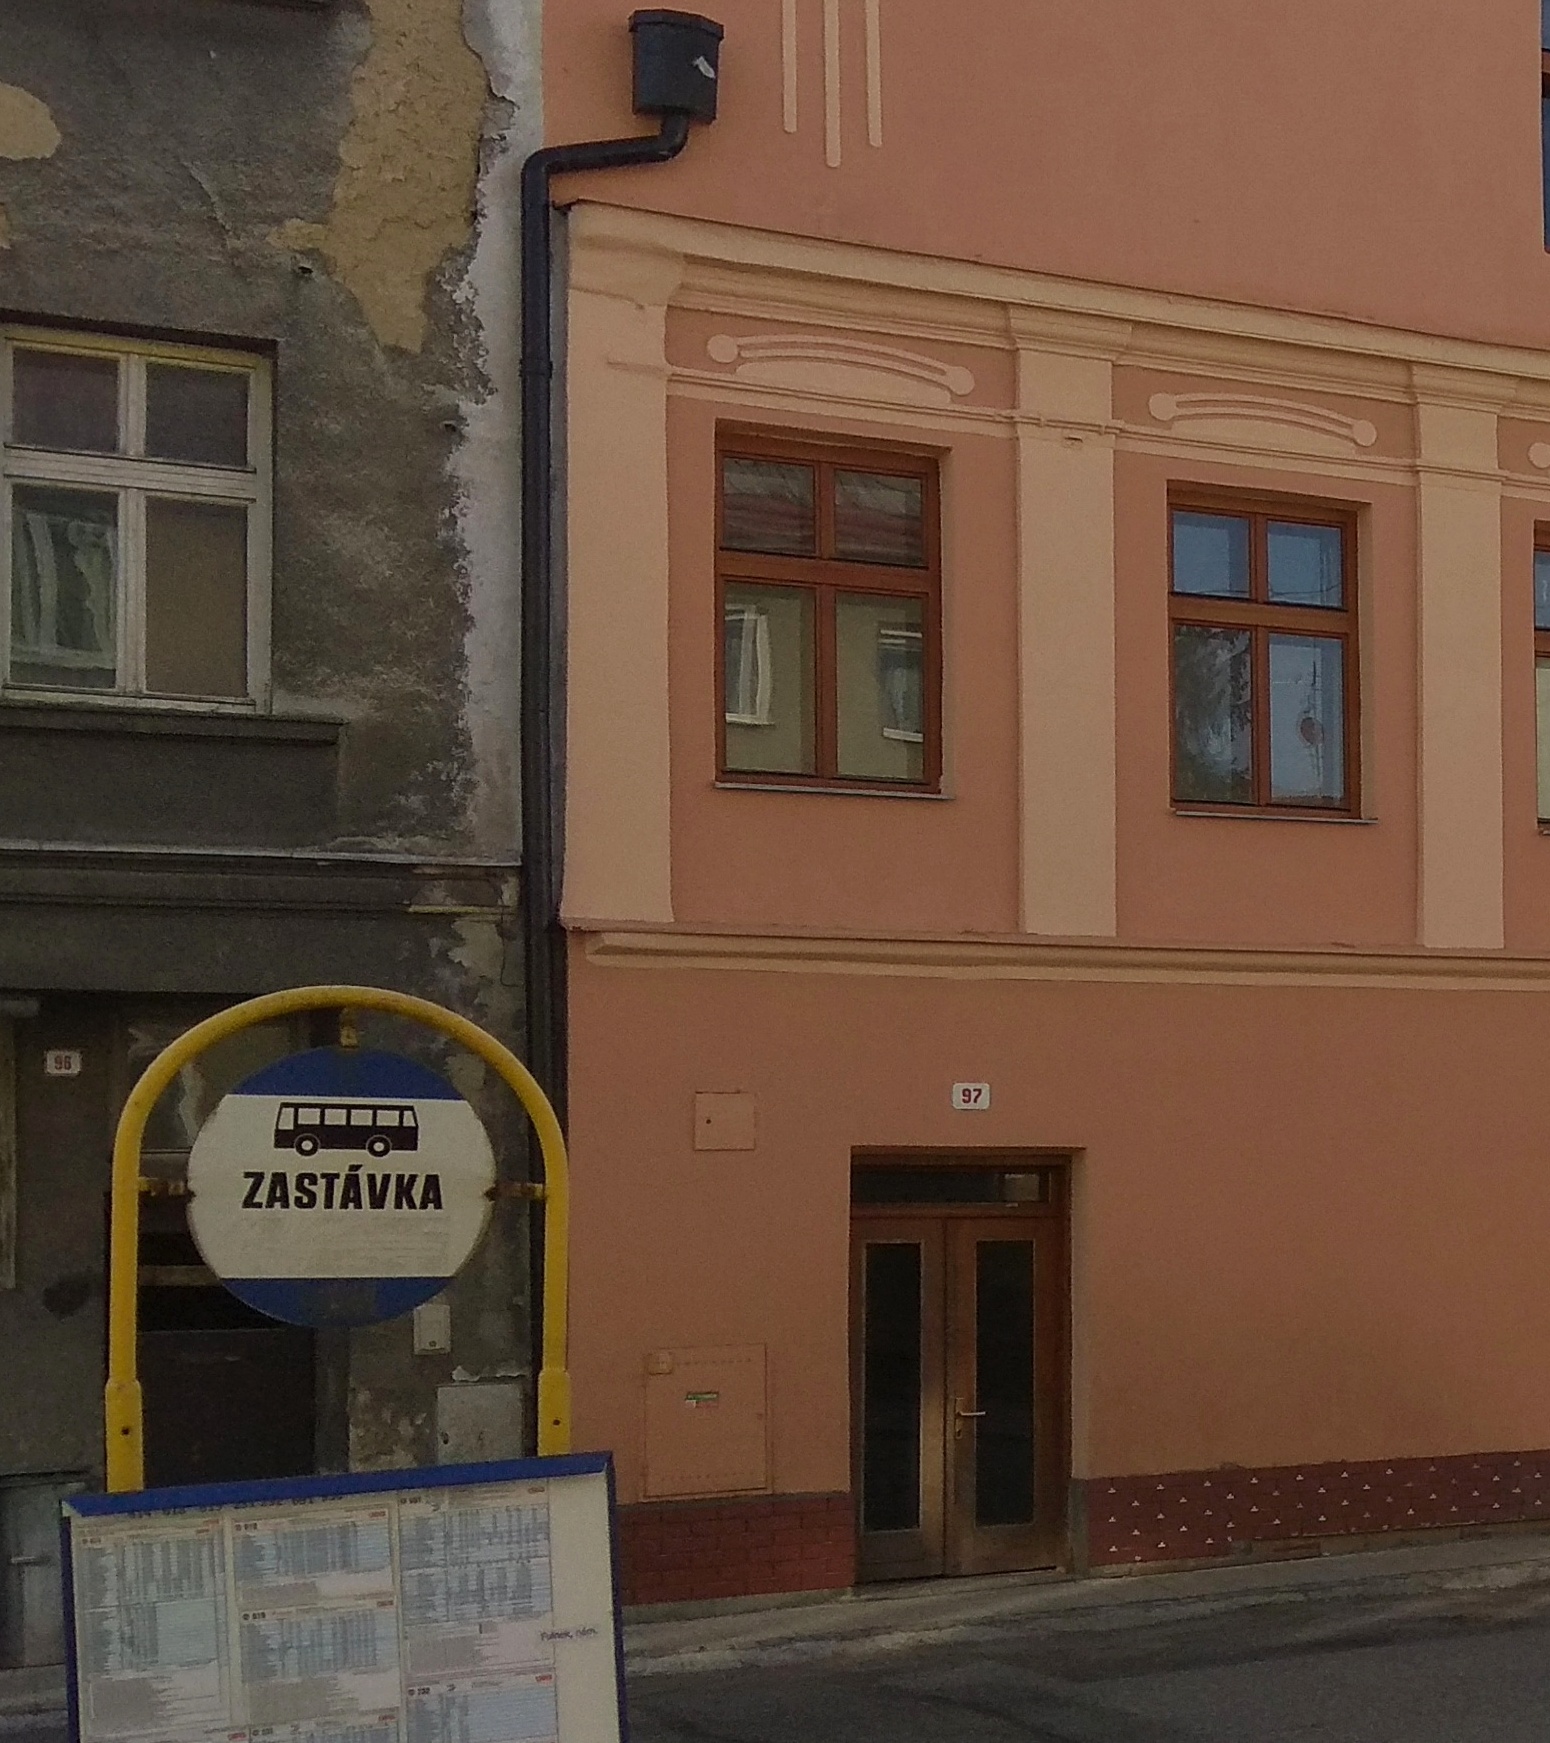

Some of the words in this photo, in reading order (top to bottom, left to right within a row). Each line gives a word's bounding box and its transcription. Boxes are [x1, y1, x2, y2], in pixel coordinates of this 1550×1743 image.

[54, 1050, 72, 1070] 96
[962, 1088, 982, 1104] 97
[242, 1164, 443, 1210] ZASTÁVKA
